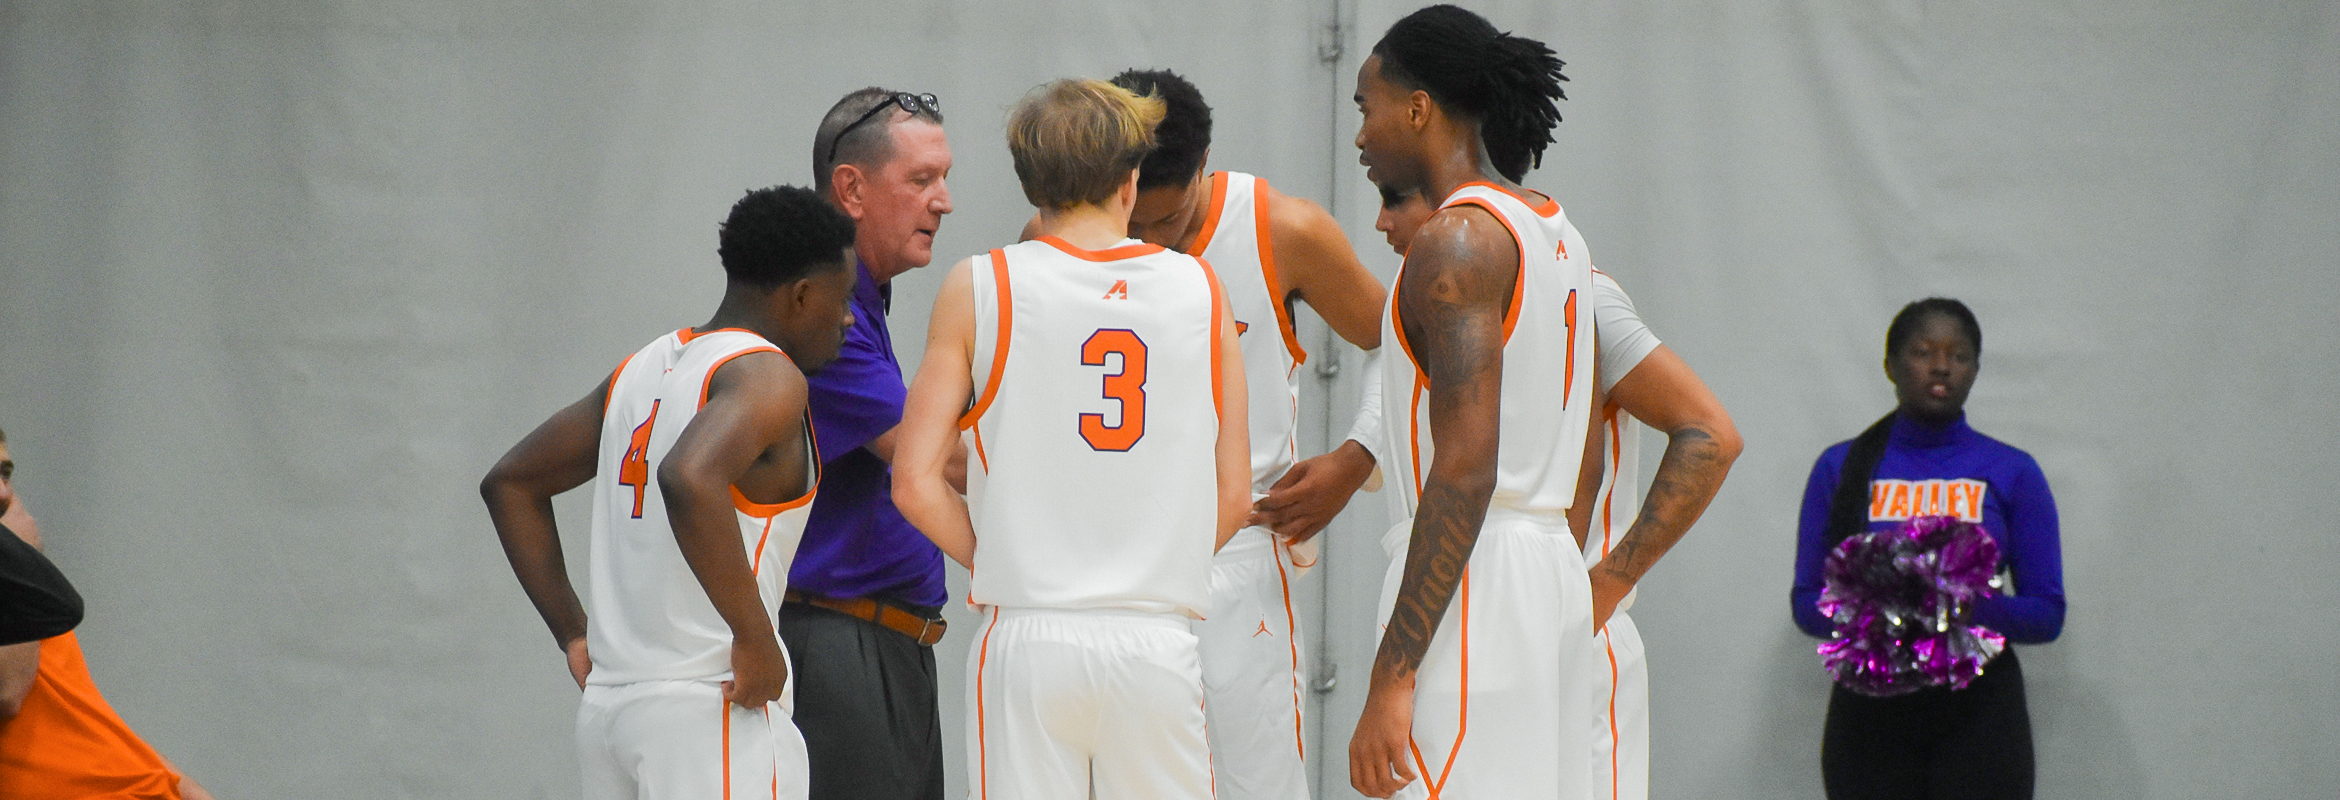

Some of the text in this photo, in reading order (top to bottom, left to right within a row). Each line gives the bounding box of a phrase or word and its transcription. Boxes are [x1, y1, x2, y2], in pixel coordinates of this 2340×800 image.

[1078, 328, 1148, 452] 3
[1563, 288, 1577, 411] 1
[618, 399, 661, 519] 4
[1871, 481, 1984, 520] VALLEY
